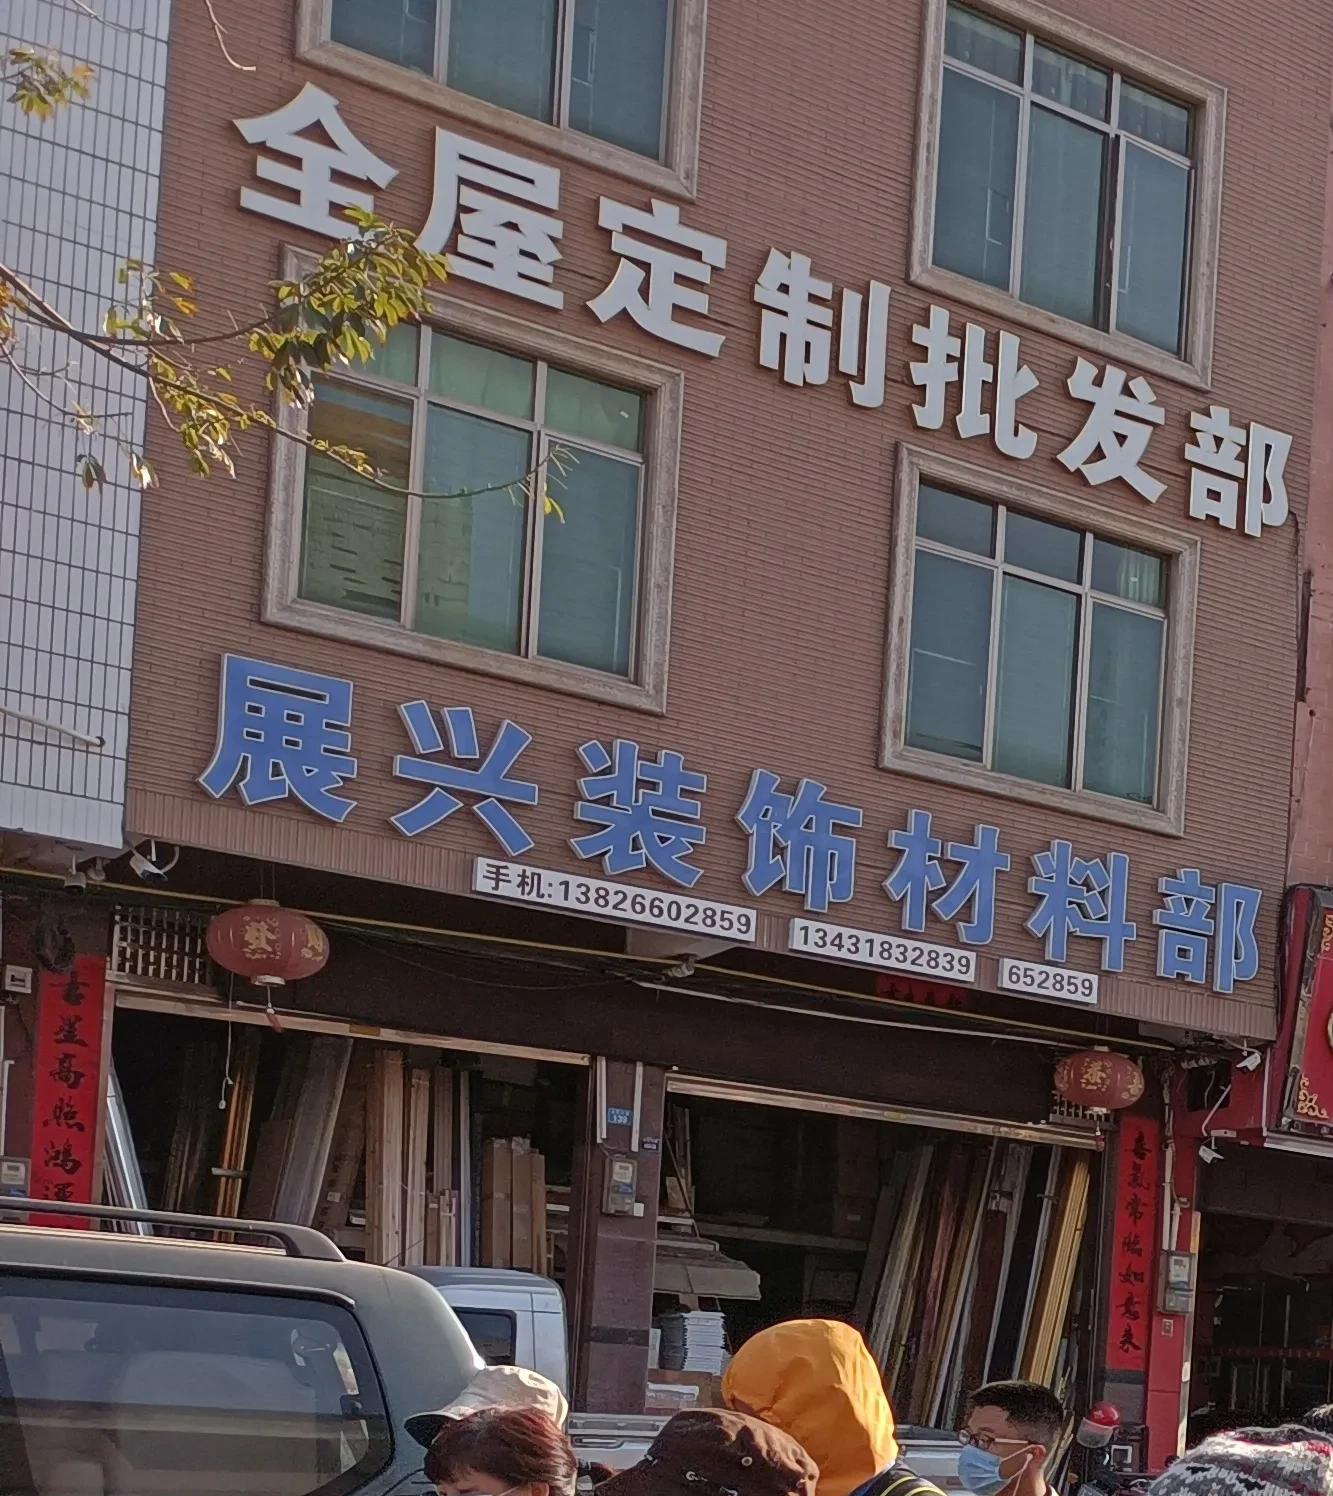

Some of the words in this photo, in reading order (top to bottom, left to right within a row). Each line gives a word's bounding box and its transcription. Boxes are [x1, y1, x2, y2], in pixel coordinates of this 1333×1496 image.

[235, 81, 1294, 539] 全屋定制批发部
[200, 653, 1264, 993] 展兴装饰材料部
[482, 862, 752, 935] 手机:13826602859
[799, 925, 971, 975] 13431832839
[1007, 964, 1095, 998] 652859
